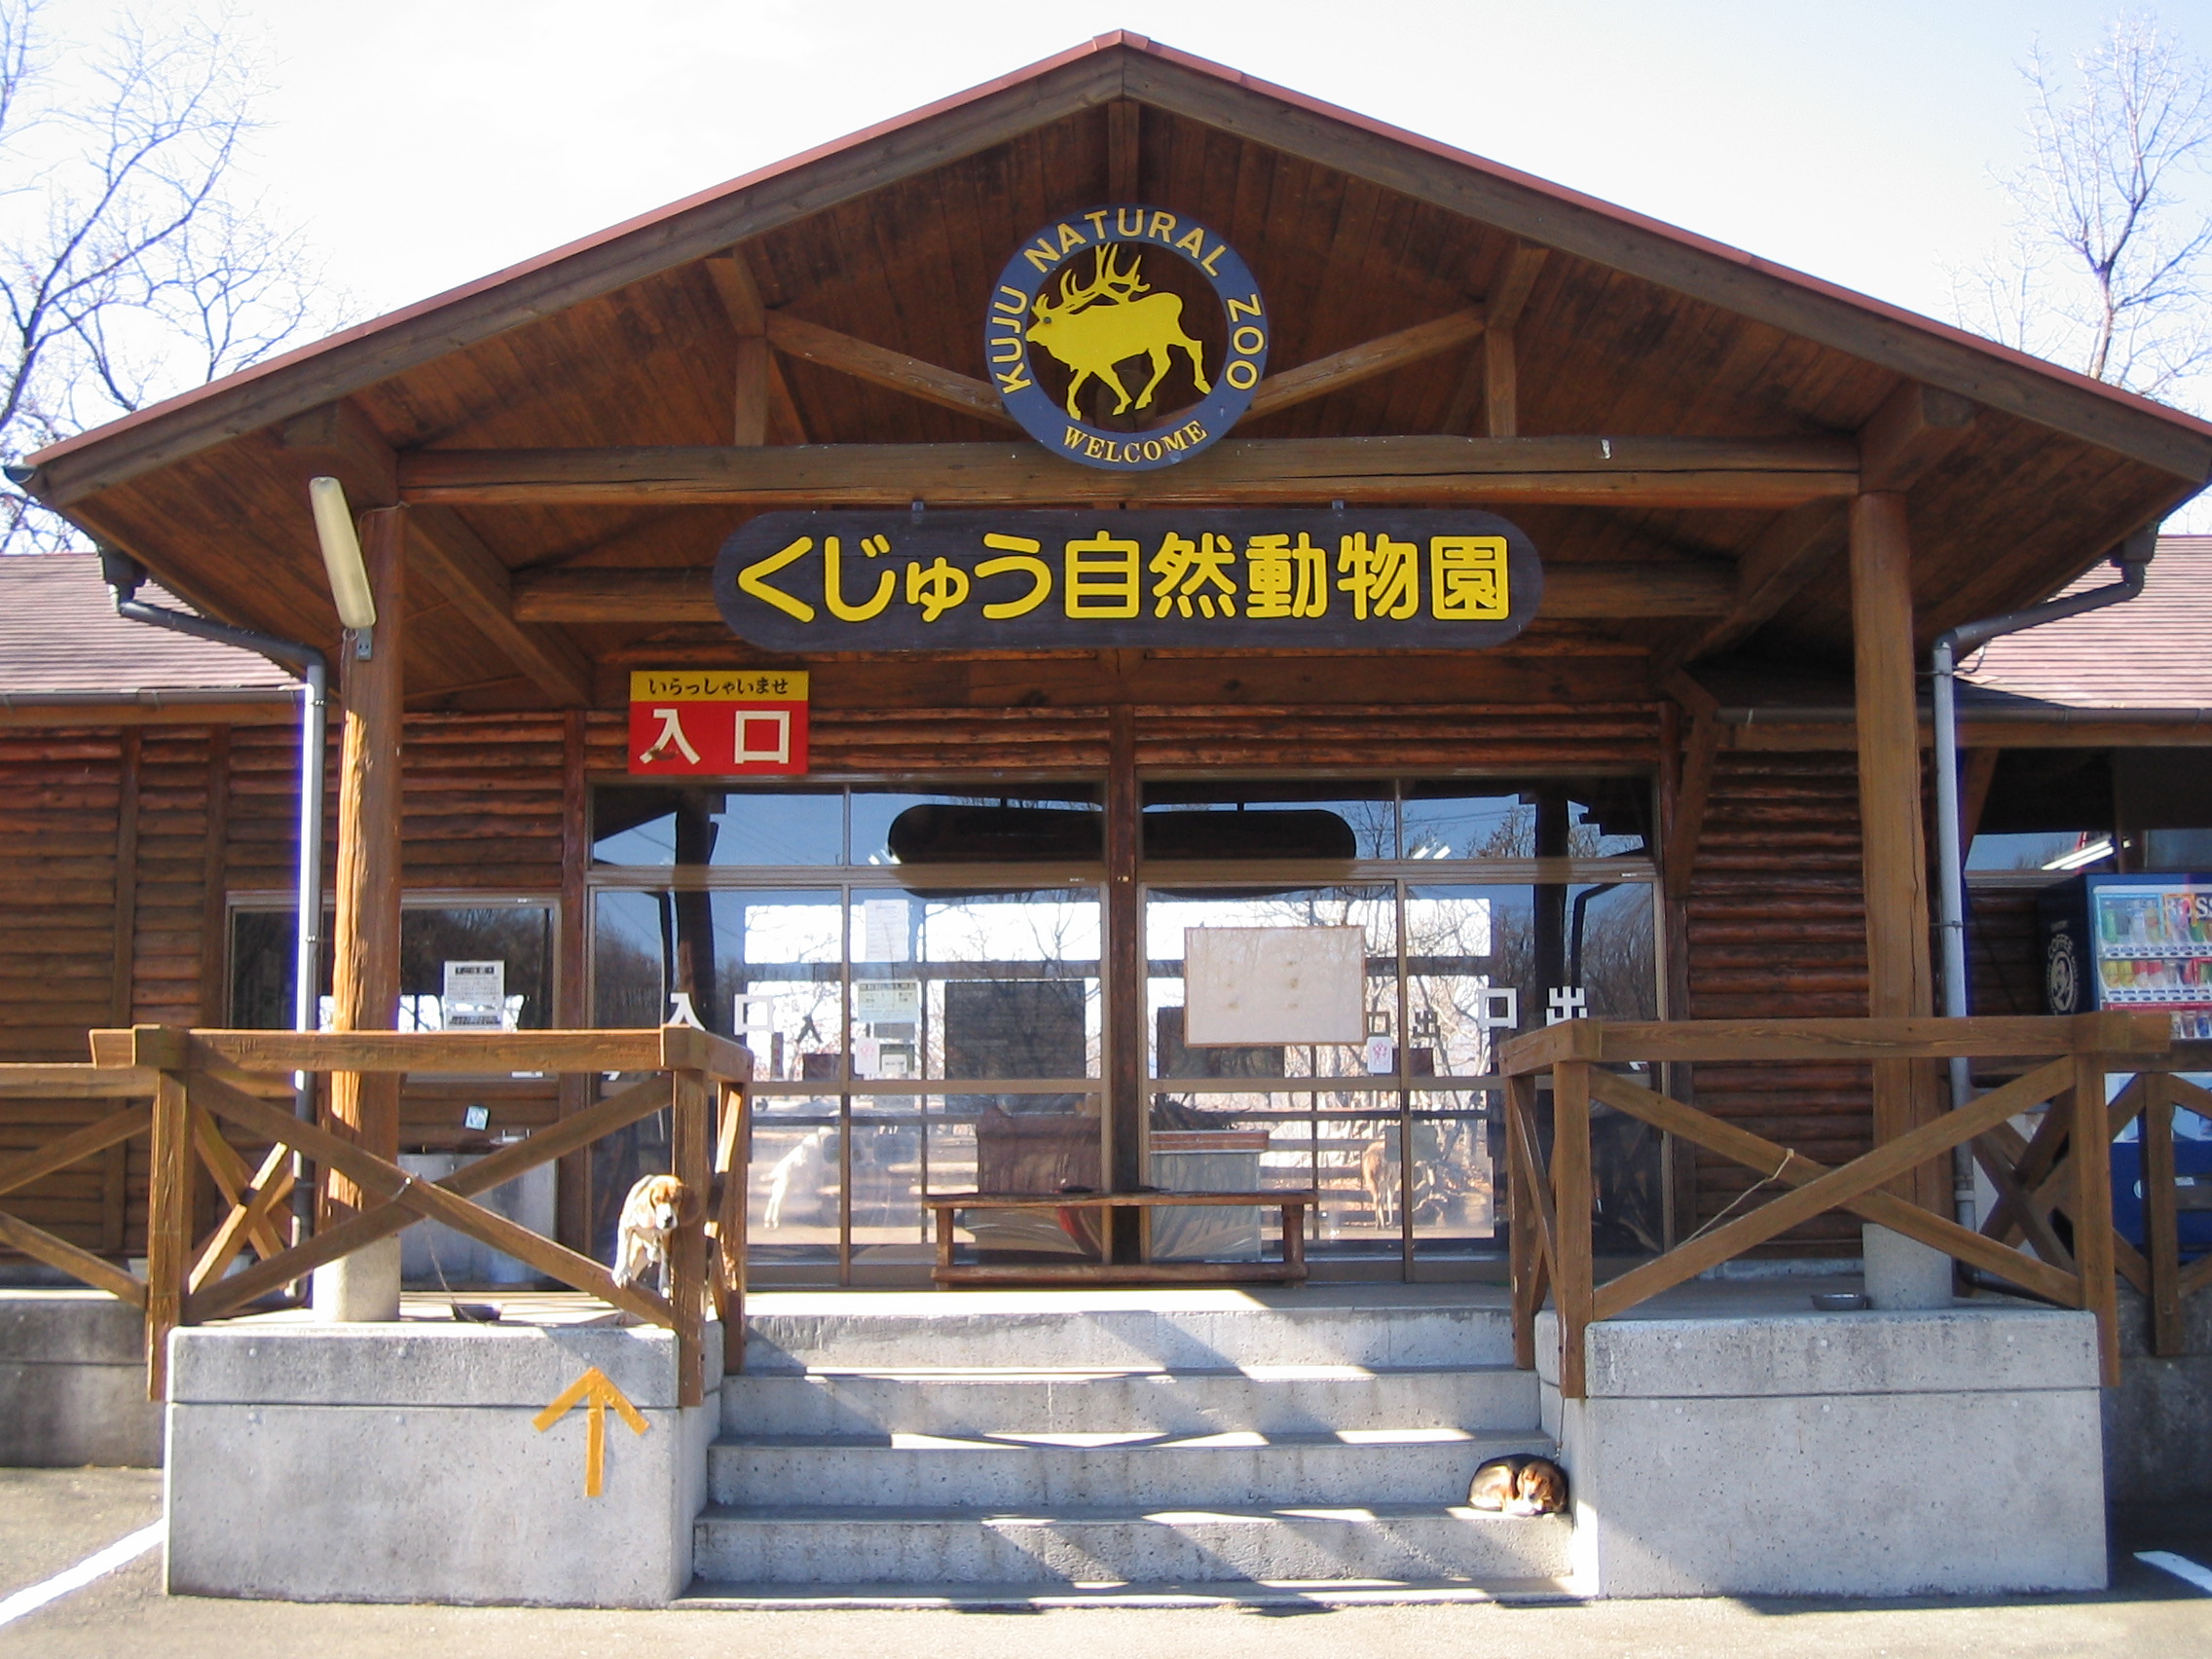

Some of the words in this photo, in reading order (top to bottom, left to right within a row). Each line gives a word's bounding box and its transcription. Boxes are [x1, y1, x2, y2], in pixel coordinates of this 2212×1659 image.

[991, 285, 1032, 393] KUJU
[1023, 207, 1227, 277] NATURAL
[1225, 293, 1264, 389] ZOO
[1061, 420, 1207, 463] WELCOME
[737, 530, 1511, 623] くじゅう自然動物園
[648, 677, 789, 695] いらっしゃいませ
[639, 708, 791, 764] 入口
